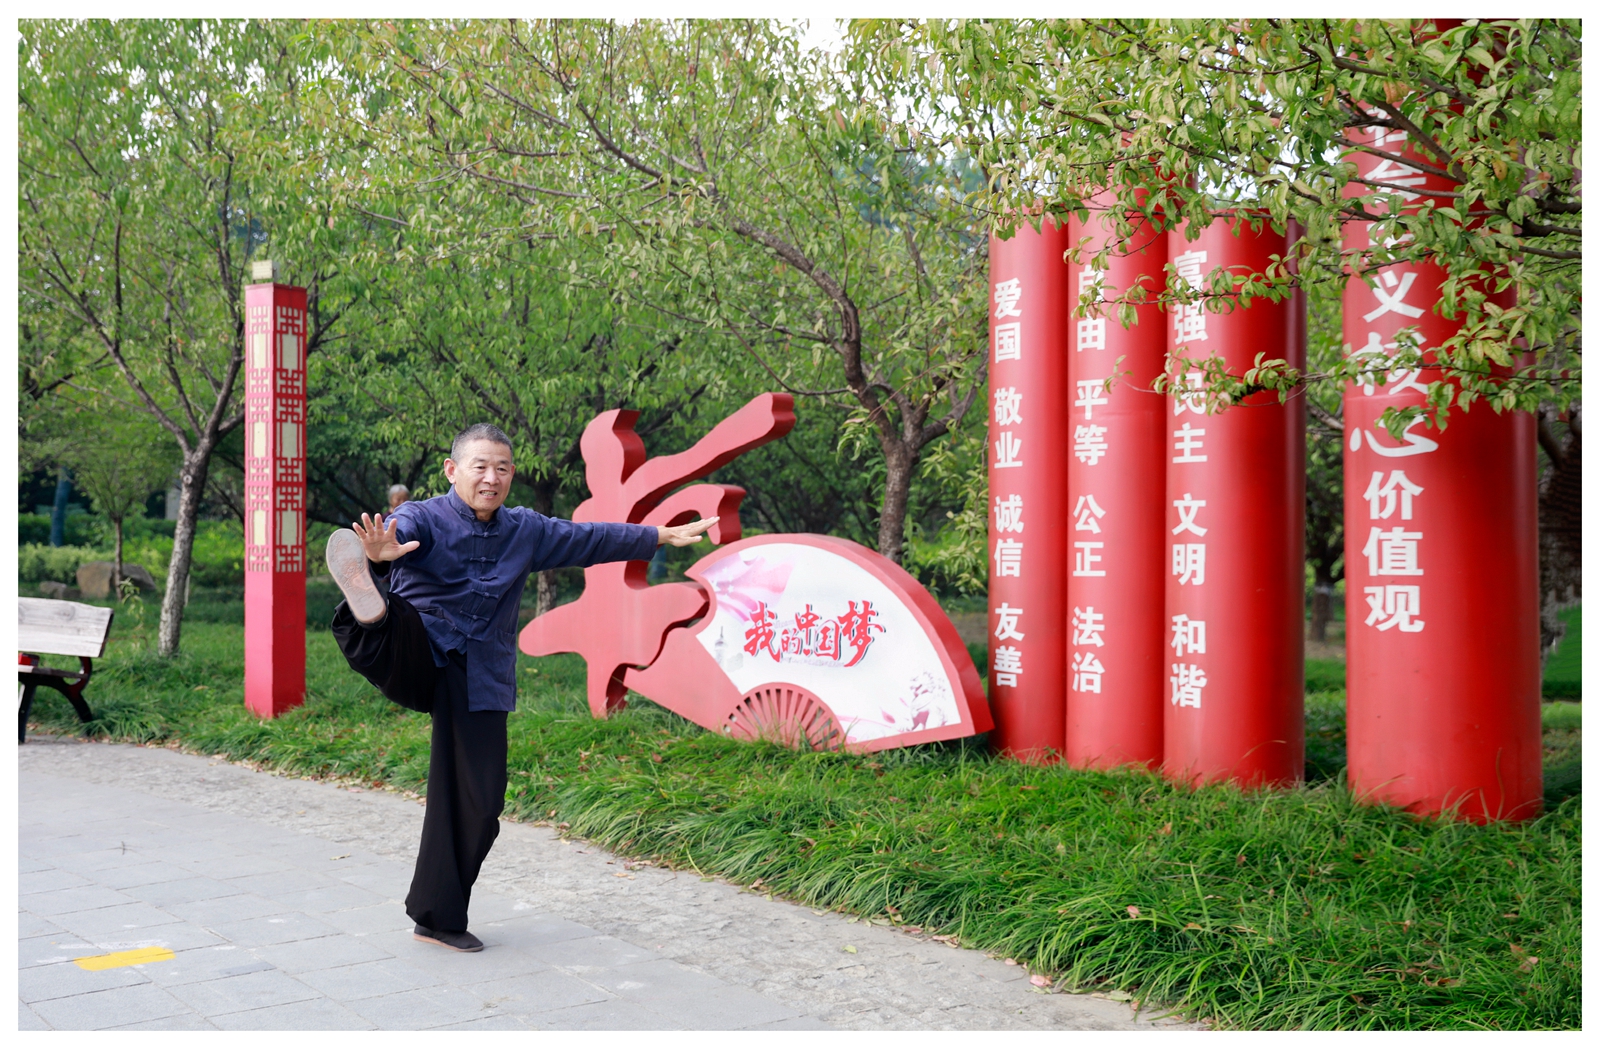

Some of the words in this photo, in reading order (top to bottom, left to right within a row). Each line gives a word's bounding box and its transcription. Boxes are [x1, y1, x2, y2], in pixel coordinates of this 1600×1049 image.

[994, 278, 1023, 363] 爱国
[1077, 264, 1106, 352] 自由
[1173, 250, 1209, 345] 富强
[994, 386, 1023, 469] 敬业
[1073, 379, 1108, 466] 平等
[1172, 372, 1208, 464] 民主
[994, 494, 1025, 577] 诚信
[1073, 494, 1106, 577] 公正
[1171, 493, 1208, 586] 文明
[743, 600, 886, 668] 我的中国梦
[994, 602, 1025, 688] 友善
[1071, 606, 1106, 694] 法治
[1170, 613, 1208, 708] 和谐
